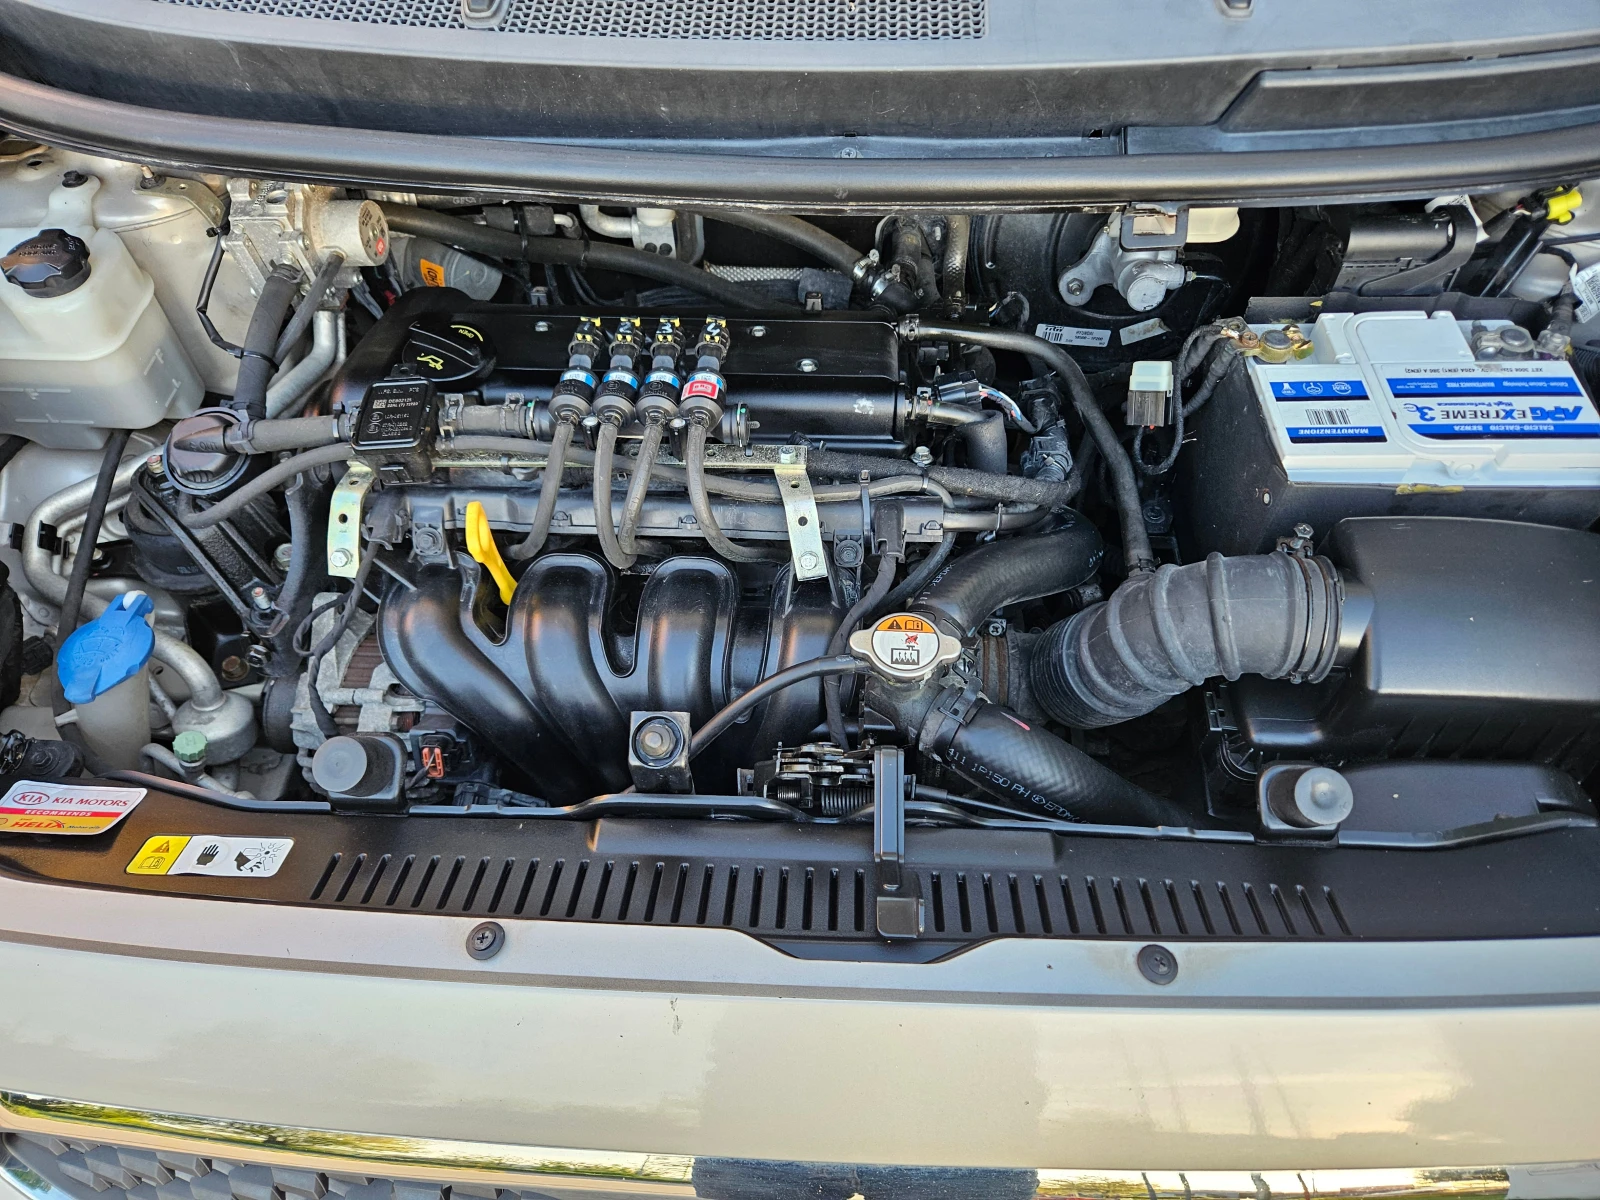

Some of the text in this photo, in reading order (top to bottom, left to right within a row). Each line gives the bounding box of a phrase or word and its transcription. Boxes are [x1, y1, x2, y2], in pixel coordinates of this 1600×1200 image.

[620, 322, 632, 334] 2
[661, 322, 673, 334] 3
[707, 322, 721, 336] 4
[458, 328, 475, 339] OPEN
[1493, 400, 1513, 408] High
[1440, 408, 1526, 421] EXTREME
[1298, 427, 1369, 435] MANUTENZIONE
[1453, 424, 1554, 432] CALCIO-CALCIO SENZA
[18, 793, 43, 803] KIA
[51, 796, 129, 806] KIA MOTORS
[24, 809, 93, 817] RECOMMENDS
[10, 819, 66, 829] HELIX
